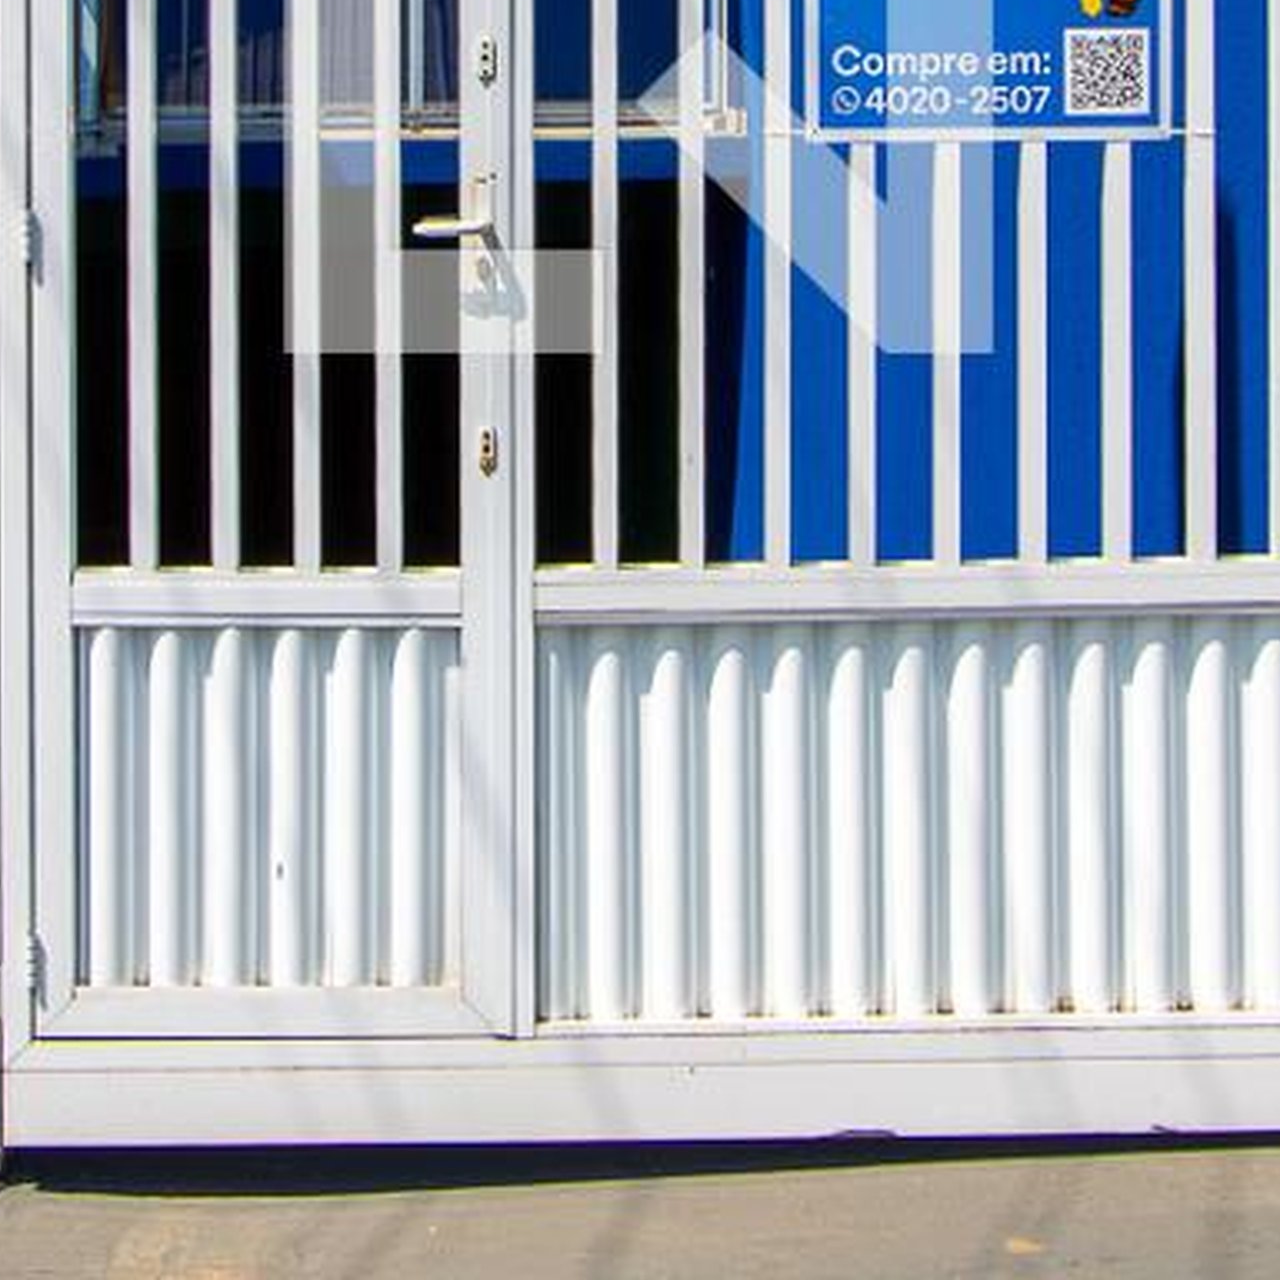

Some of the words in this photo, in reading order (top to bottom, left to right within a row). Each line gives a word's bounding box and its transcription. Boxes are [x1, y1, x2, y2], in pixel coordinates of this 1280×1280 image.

[831, 44, 979, 82] Compre
[986, 49, 1053, 76] em:
[864, 86, 1051, 115] 4020-2507
